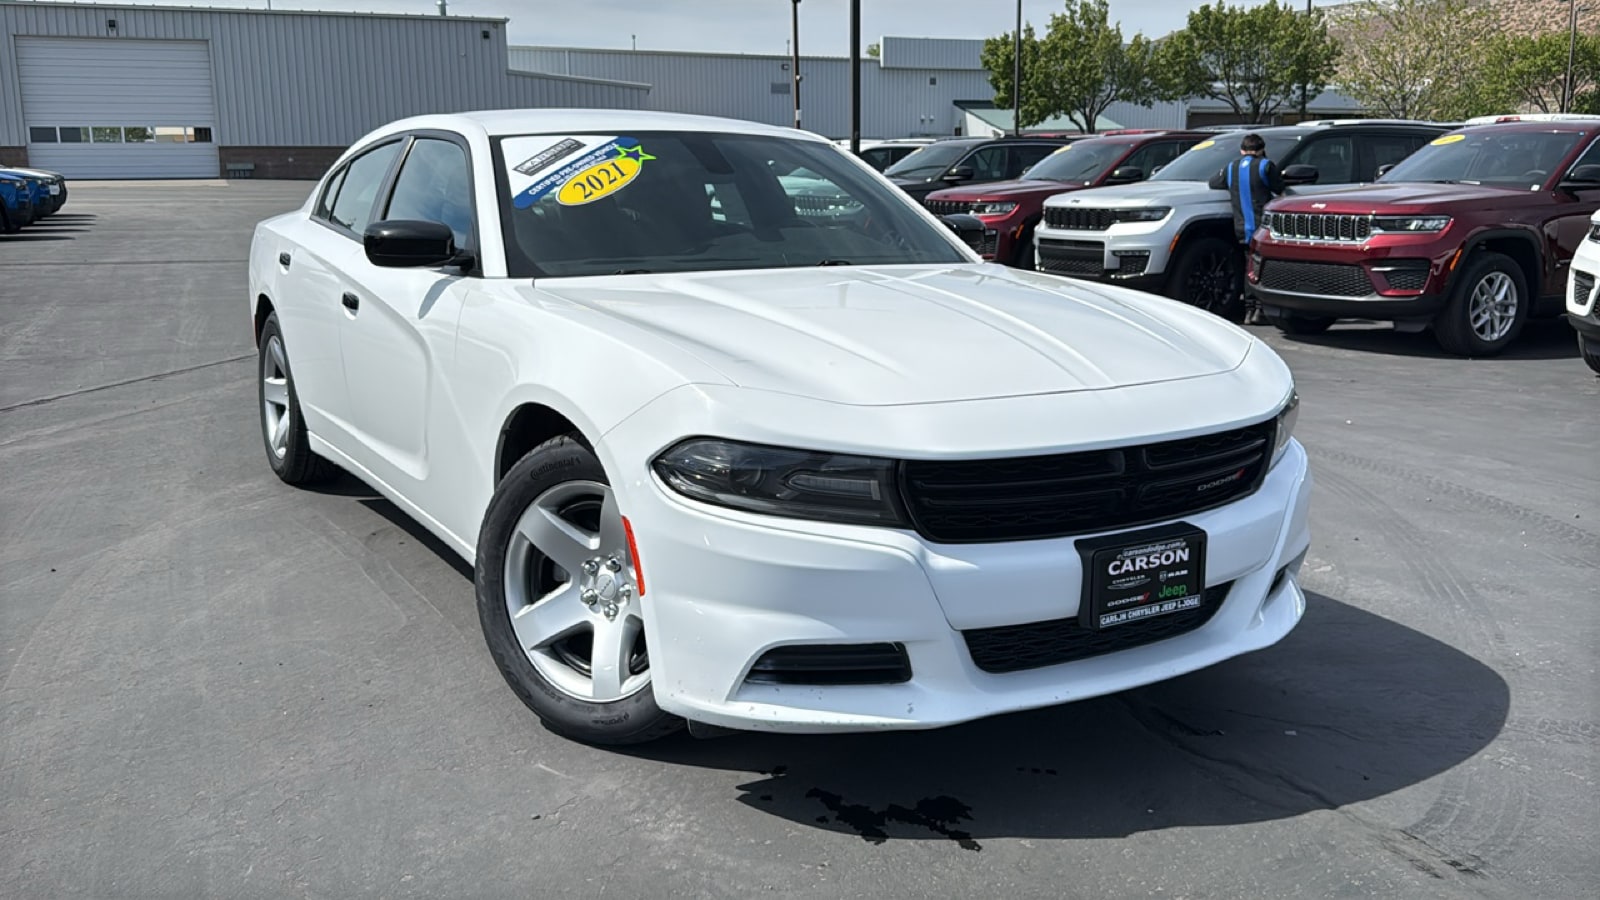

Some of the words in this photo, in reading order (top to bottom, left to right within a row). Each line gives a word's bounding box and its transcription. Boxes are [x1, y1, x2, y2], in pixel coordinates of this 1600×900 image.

[573, 162, 628, 199] 2021
[1108, 548, 1190, 575] CARSON
[1168, 569, 1189, 578] RAM
[1158, 584, 1187, 598] Jeep
[1107, 595, 1145, 607] DODGE
[1128, 604, 1160, 619] CHRYSLER
[1161, 601, 1177, 612] JEEP
